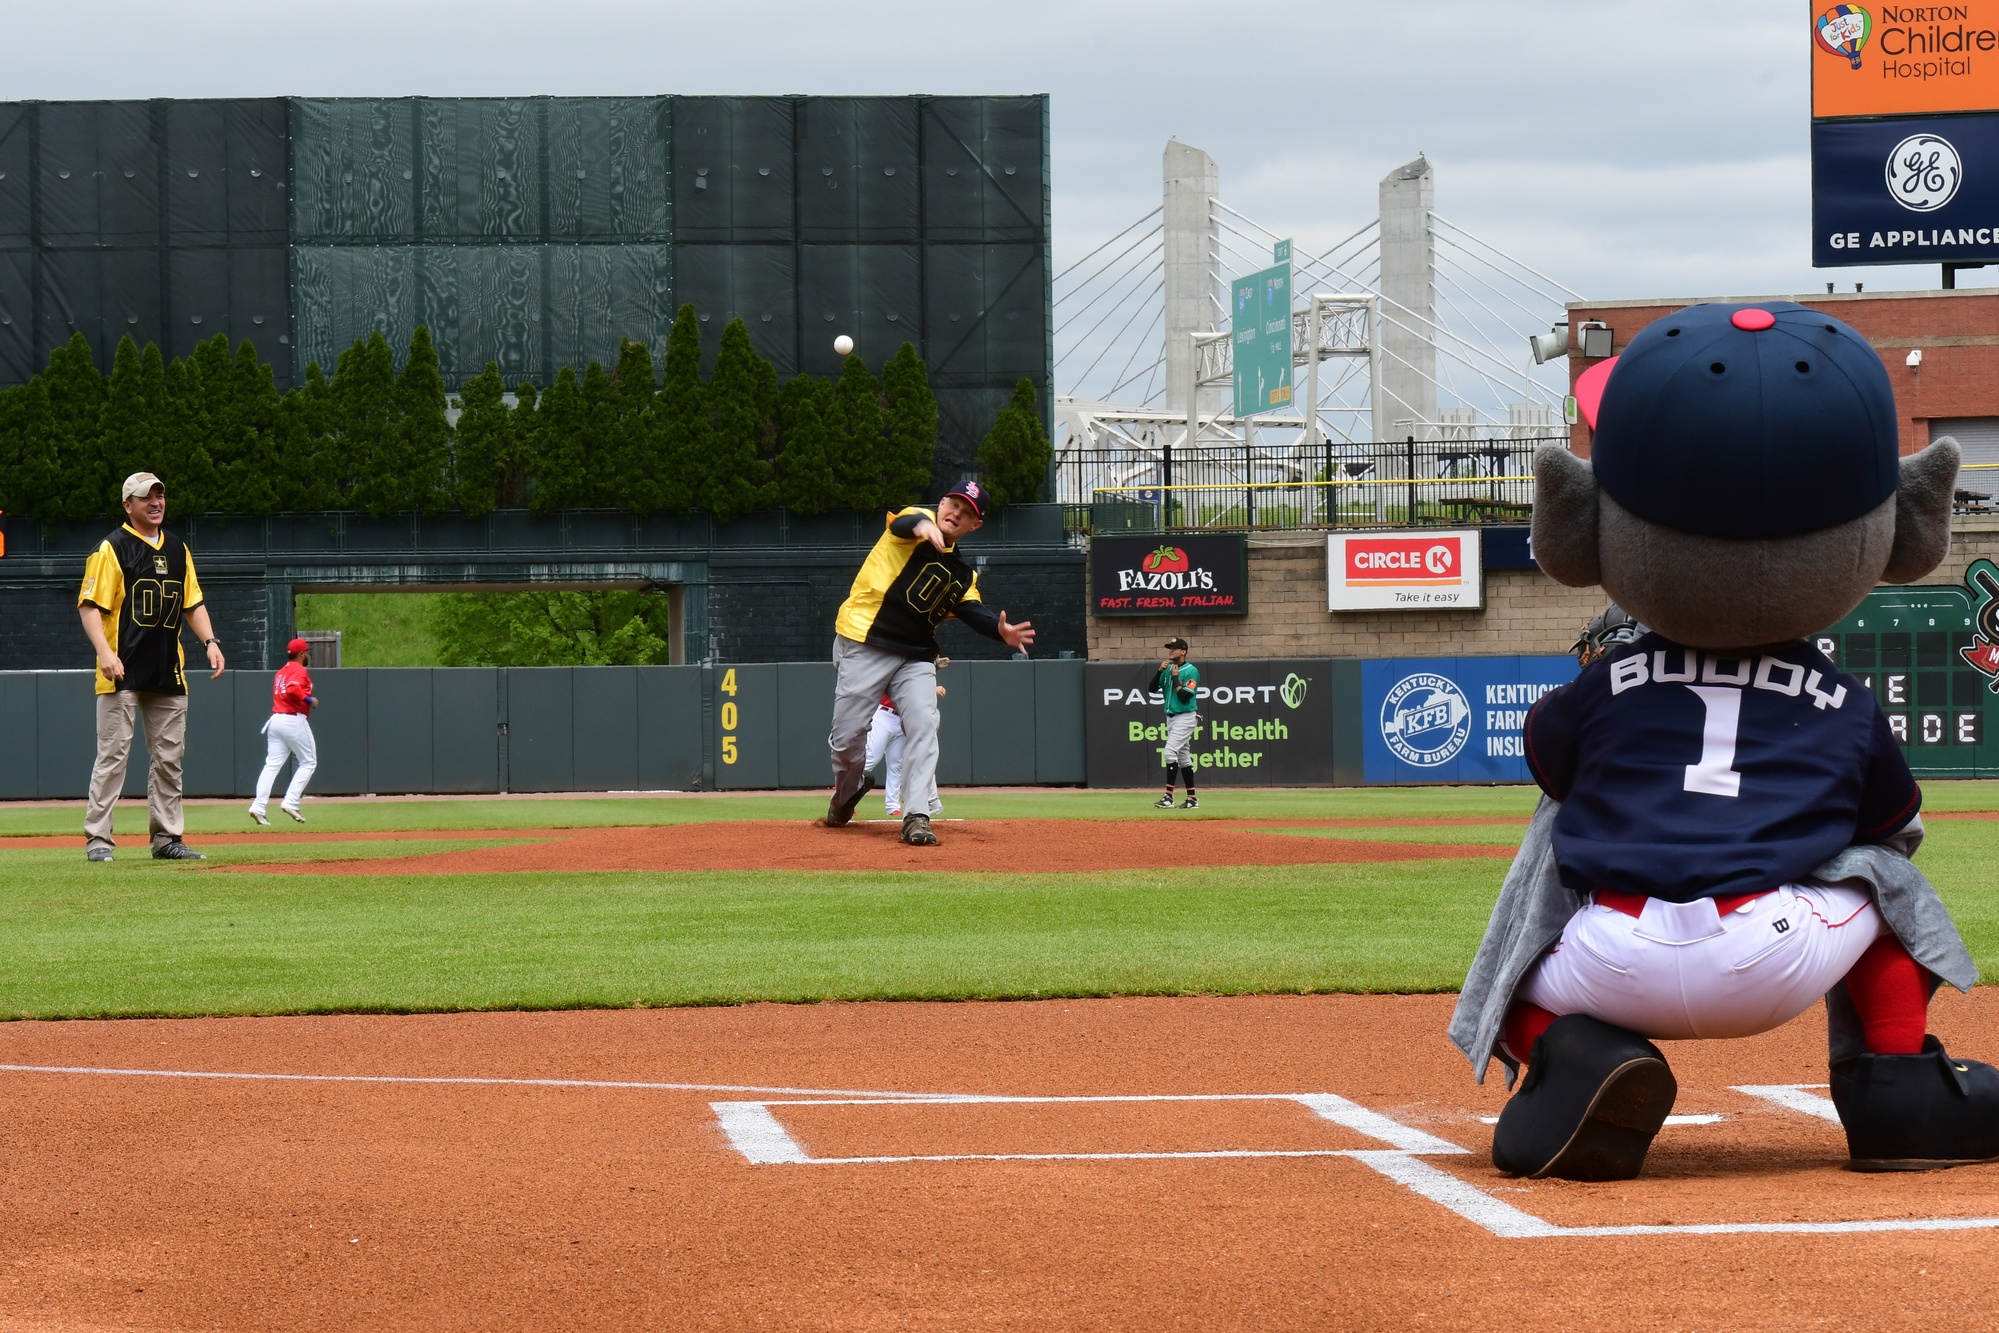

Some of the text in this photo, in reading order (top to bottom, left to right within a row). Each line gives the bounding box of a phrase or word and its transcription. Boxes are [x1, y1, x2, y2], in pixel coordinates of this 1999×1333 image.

[1881, 5, 1968, 24] NORTON
[1830, 18, 1849, 33] Just
[1840, 23, 1861, 40] Kids
[1880, 24, 1999, 55] Childre
[1883, 56, 1971, 81] Hospital
[1829, 232, 1860, 249] GE
[1354, 549, 1452, 572] CIRCLE K
[131, 578, 182, 629] 07
[1100, 594, 1235, 608] FAST. FRESH. ITALIAN.
[1394, 592, 1460, 604] Take it easy
[1857, 619, 1865, 627] 6
[1893, 618, 1900, 627] 7
[1928, 618, 1936, 626] 8
[1964, 617, 1971, 626] 9
[1388, 676, 1454, 704] KENTUCKY
[1610, 649, 1848, 710] BUDDY
[1103, 686, 1276, 706] PASPORT
[1406, 704, 1448, 734] KFB
[1129, 718, 1289, 742] Betr Health
[1389, 727, 1466, 763] FARM BUREAU
[1683, 685, 1742, 798] 1
[1156, 746, 1263, 774] Tgether
